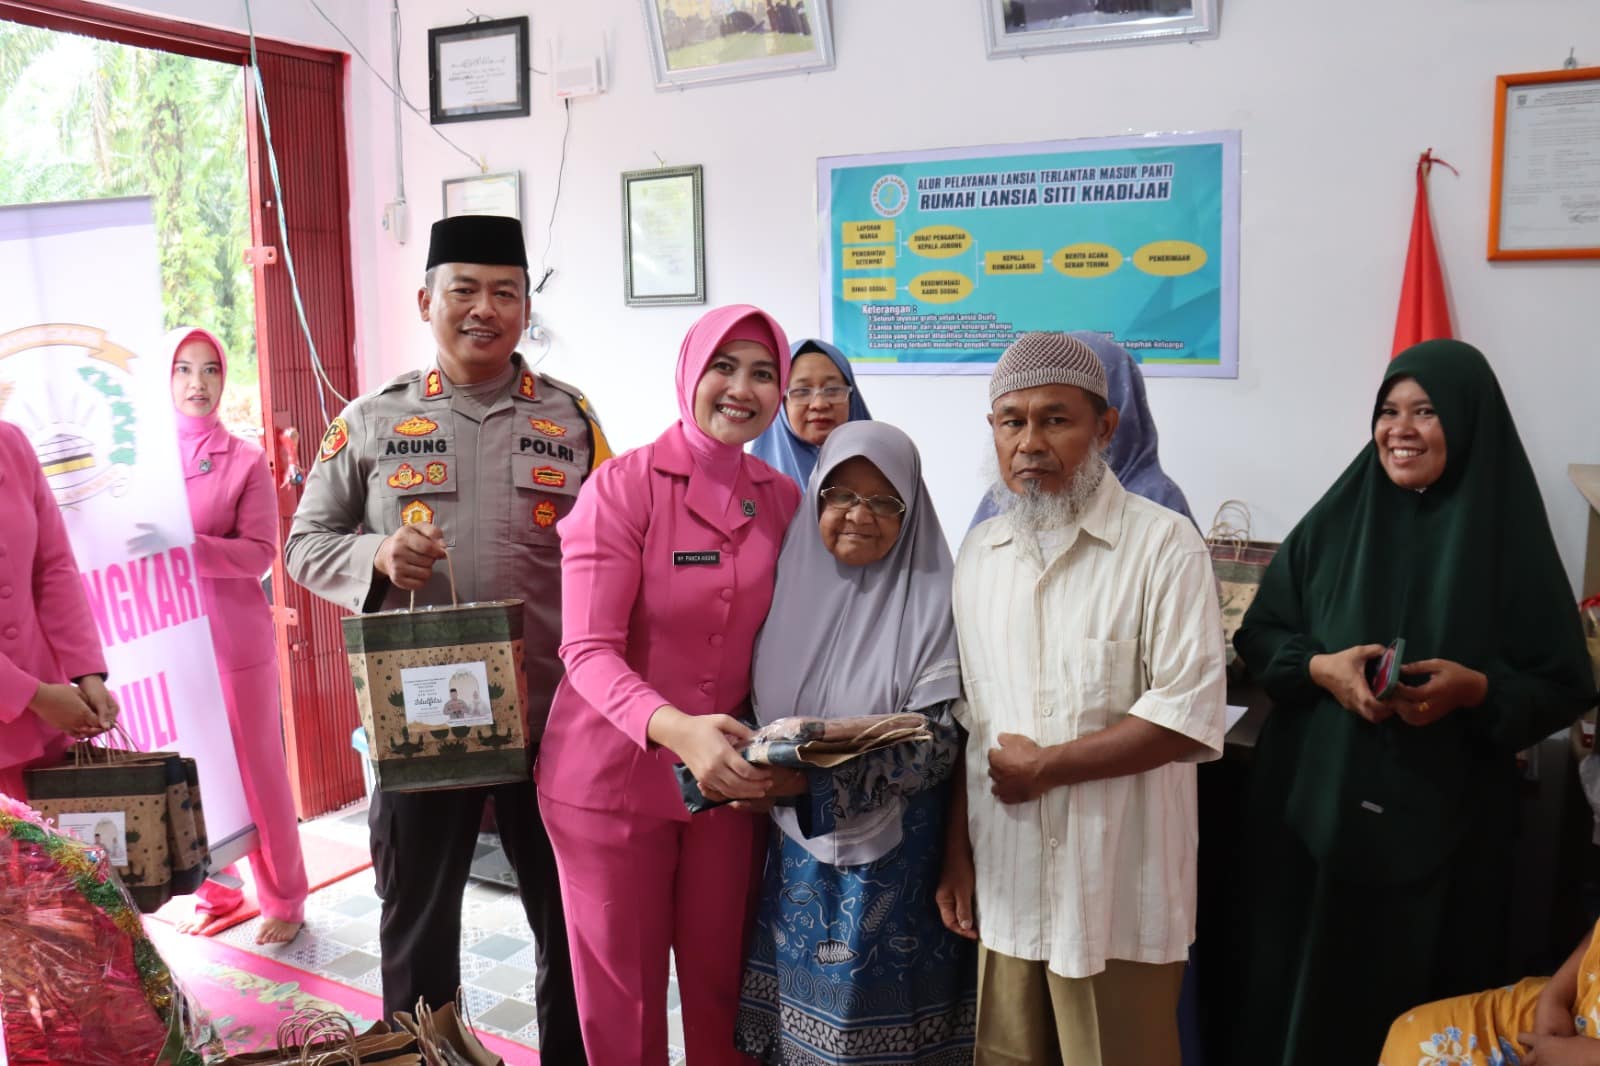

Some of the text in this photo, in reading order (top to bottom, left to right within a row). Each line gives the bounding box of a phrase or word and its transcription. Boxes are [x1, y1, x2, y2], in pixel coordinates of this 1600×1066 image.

[918, 164, 1173, 190] ALUR PELAYANAN LANSIA TERLANTAR MASUK PANTI
[920, 192, 976, 210] RUMAH
[981, 189, 1038, 207] LANSIA
[1043, 186, 1076, 204] SITI
[1081, 182, 1169, 203] KHADIJAH
[862, 304, 911, 315] Keterangan
[385, 438, 574, 462] AGUNG POLRI
